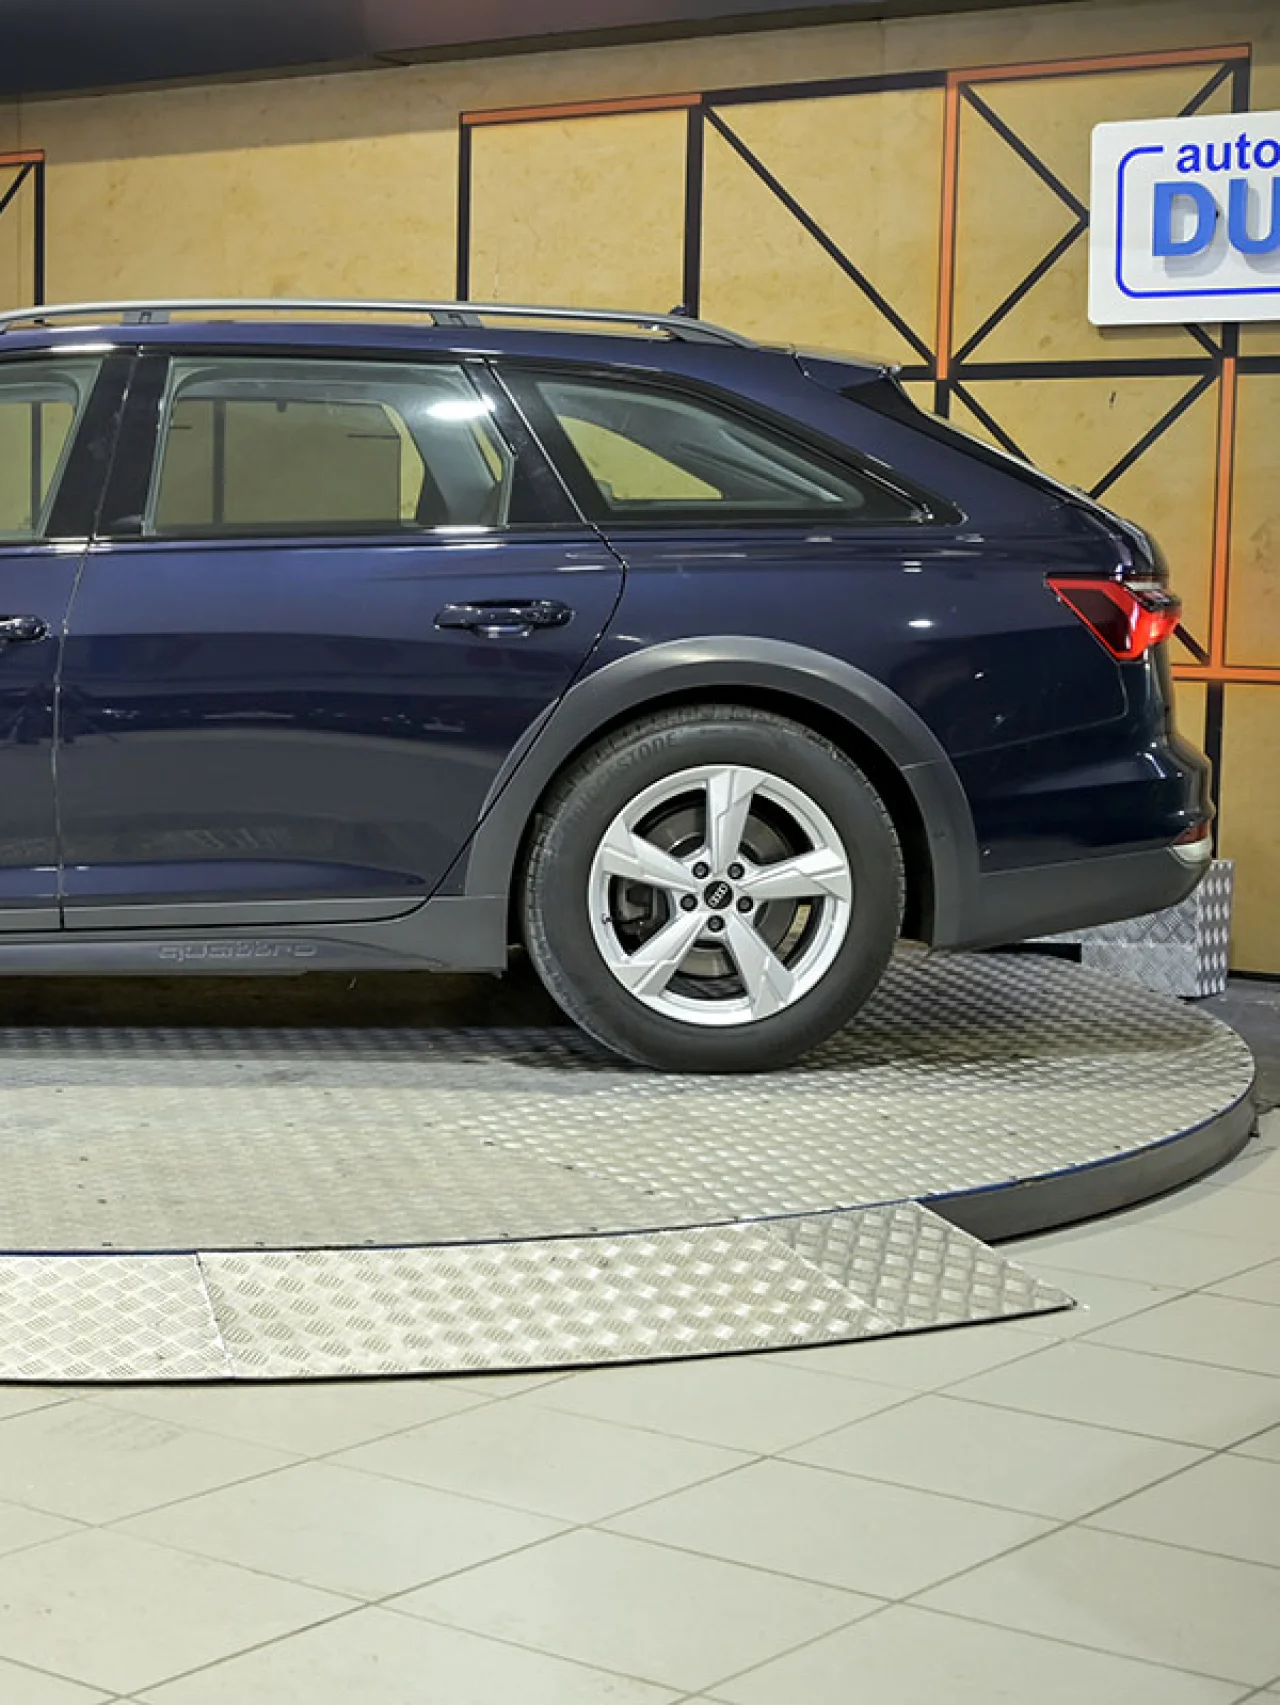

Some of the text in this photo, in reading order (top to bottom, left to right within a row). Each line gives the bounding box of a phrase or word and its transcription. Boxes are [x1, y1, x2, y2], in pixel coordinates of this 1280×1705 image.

[1176, 132, 1280, 173] auto
[1152, 176, 1280, 256] DU
[158, 940, 319, 963] quattro
